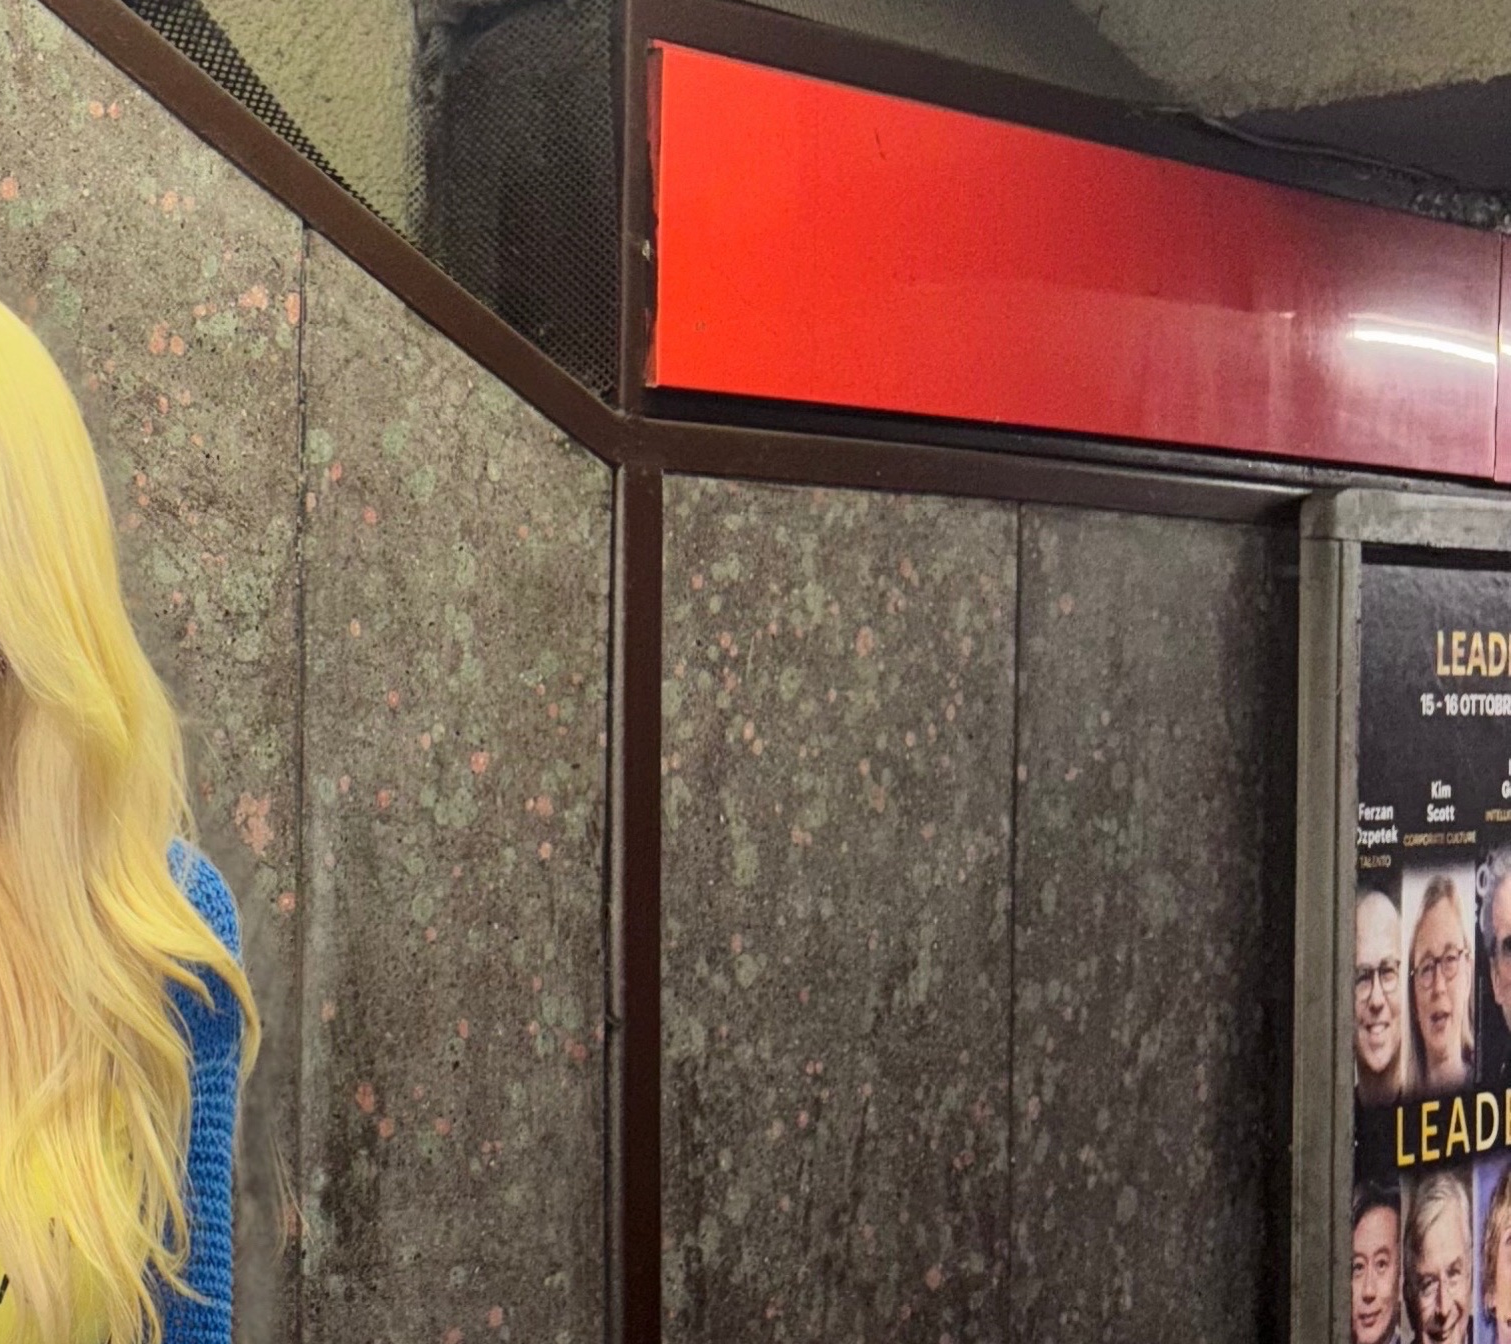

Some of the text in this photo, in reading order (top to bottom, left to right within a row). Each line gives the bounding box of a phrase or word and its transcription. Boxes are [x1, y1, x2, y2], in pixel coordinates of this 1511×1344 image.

[1436, 629, 1511, 677] LEAD
[1420, 692, 1435, 716] 15
[1444, 692, 1459, 716] 16
[1430, 779, 1452, 800] Kim
[1358, 803, 1394, 821] Ferzan
[1426, 803, 1455, 823] Scott
